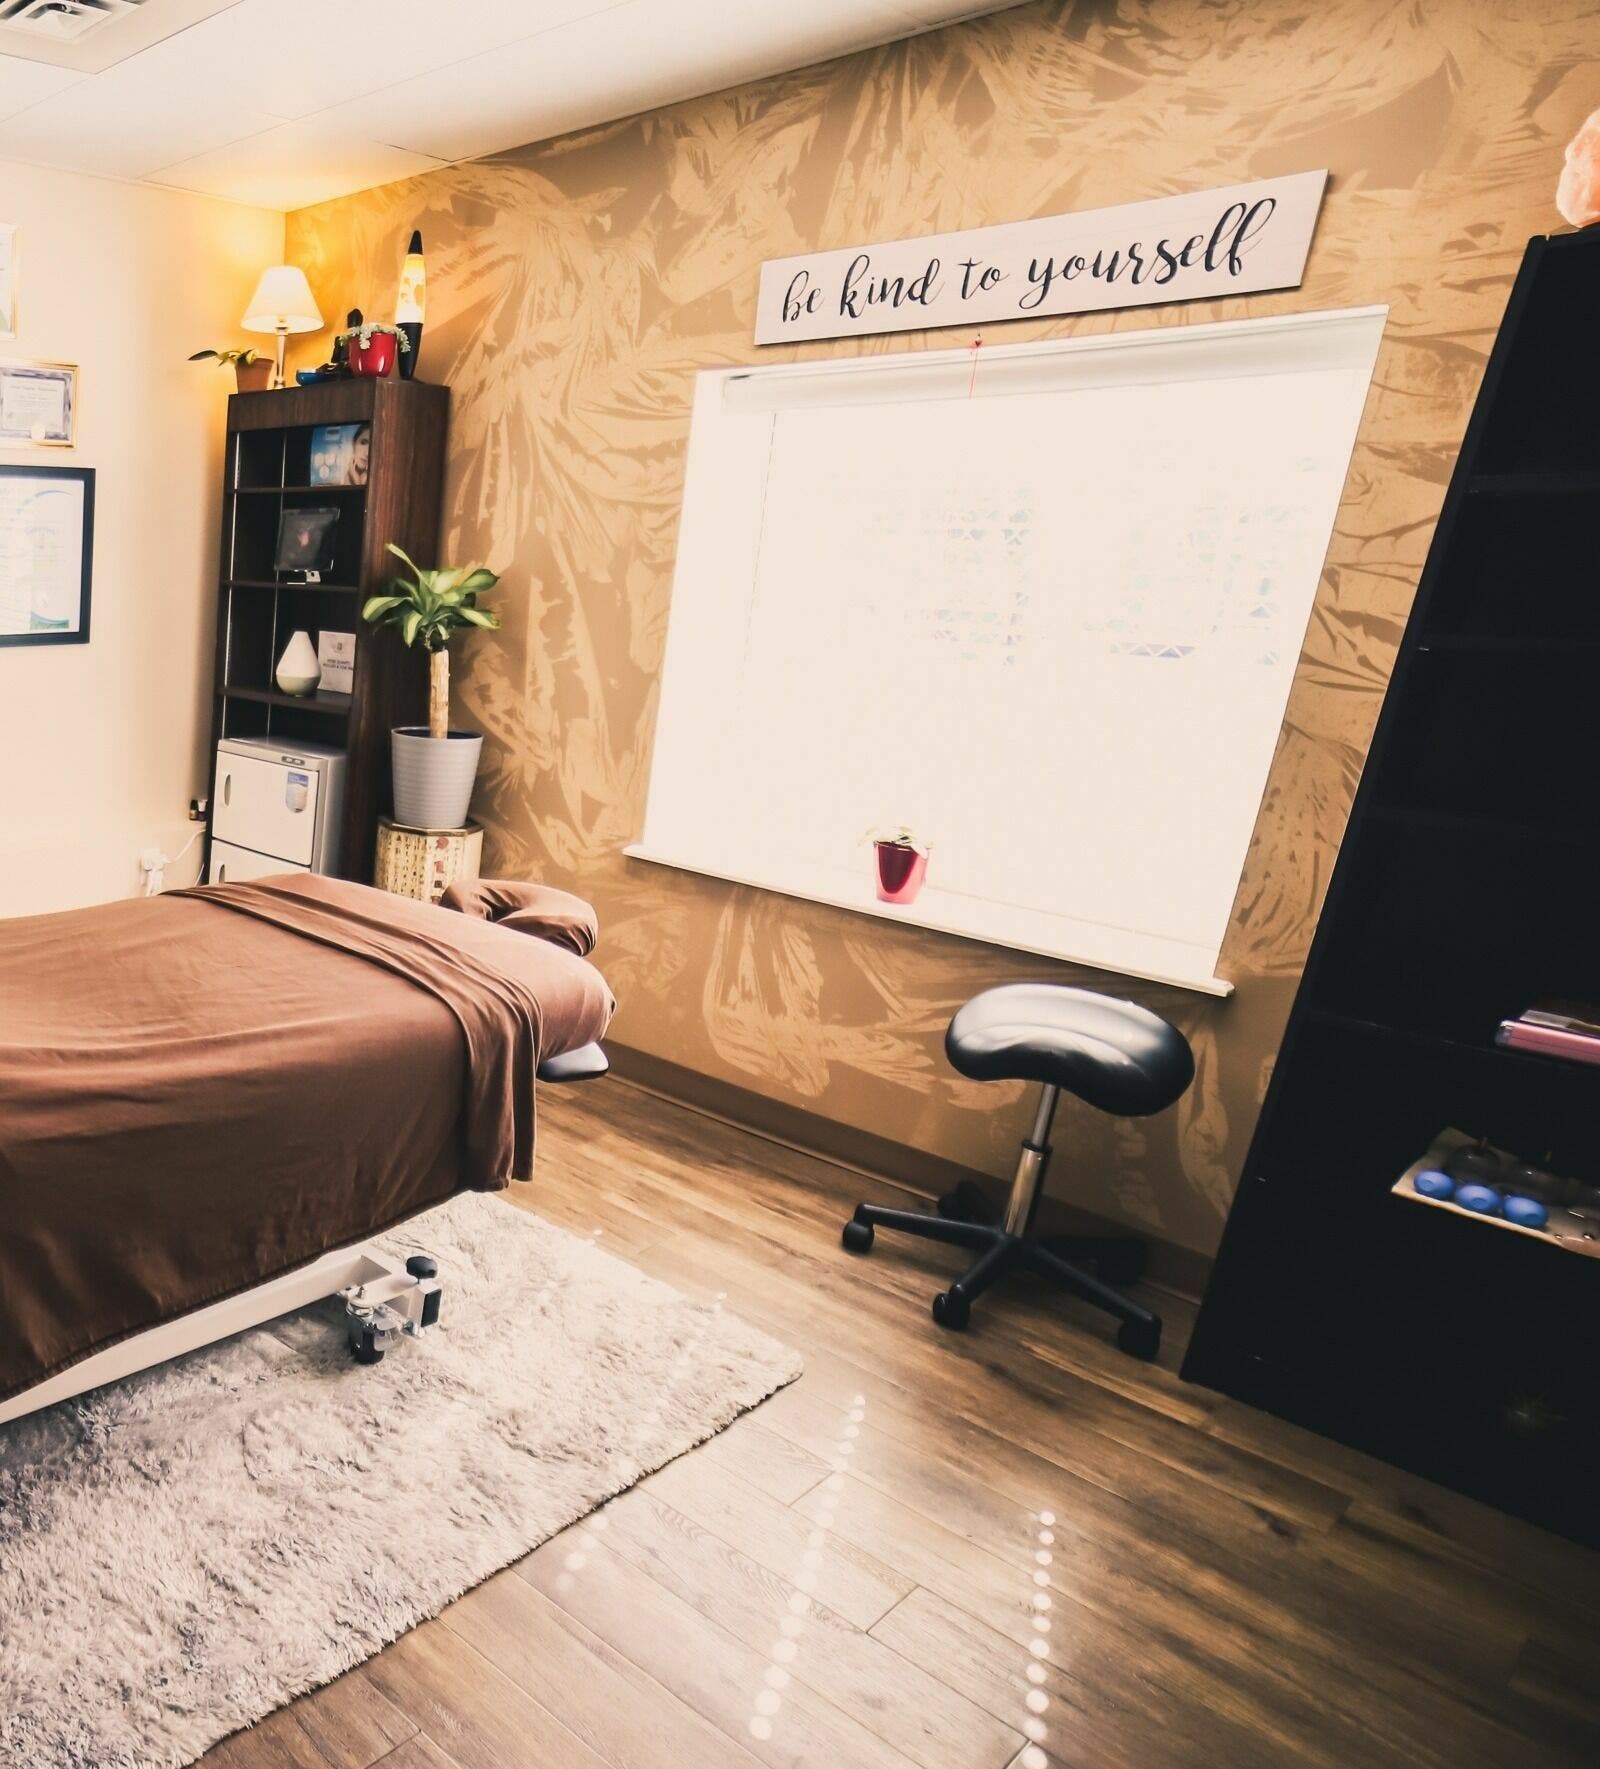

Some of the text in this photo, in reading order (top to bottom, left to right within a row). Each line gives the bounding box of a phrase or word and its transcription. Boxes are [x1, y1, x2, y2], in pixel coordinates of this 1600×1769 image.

[782, 198, 1276, 322] be kind to yourself
